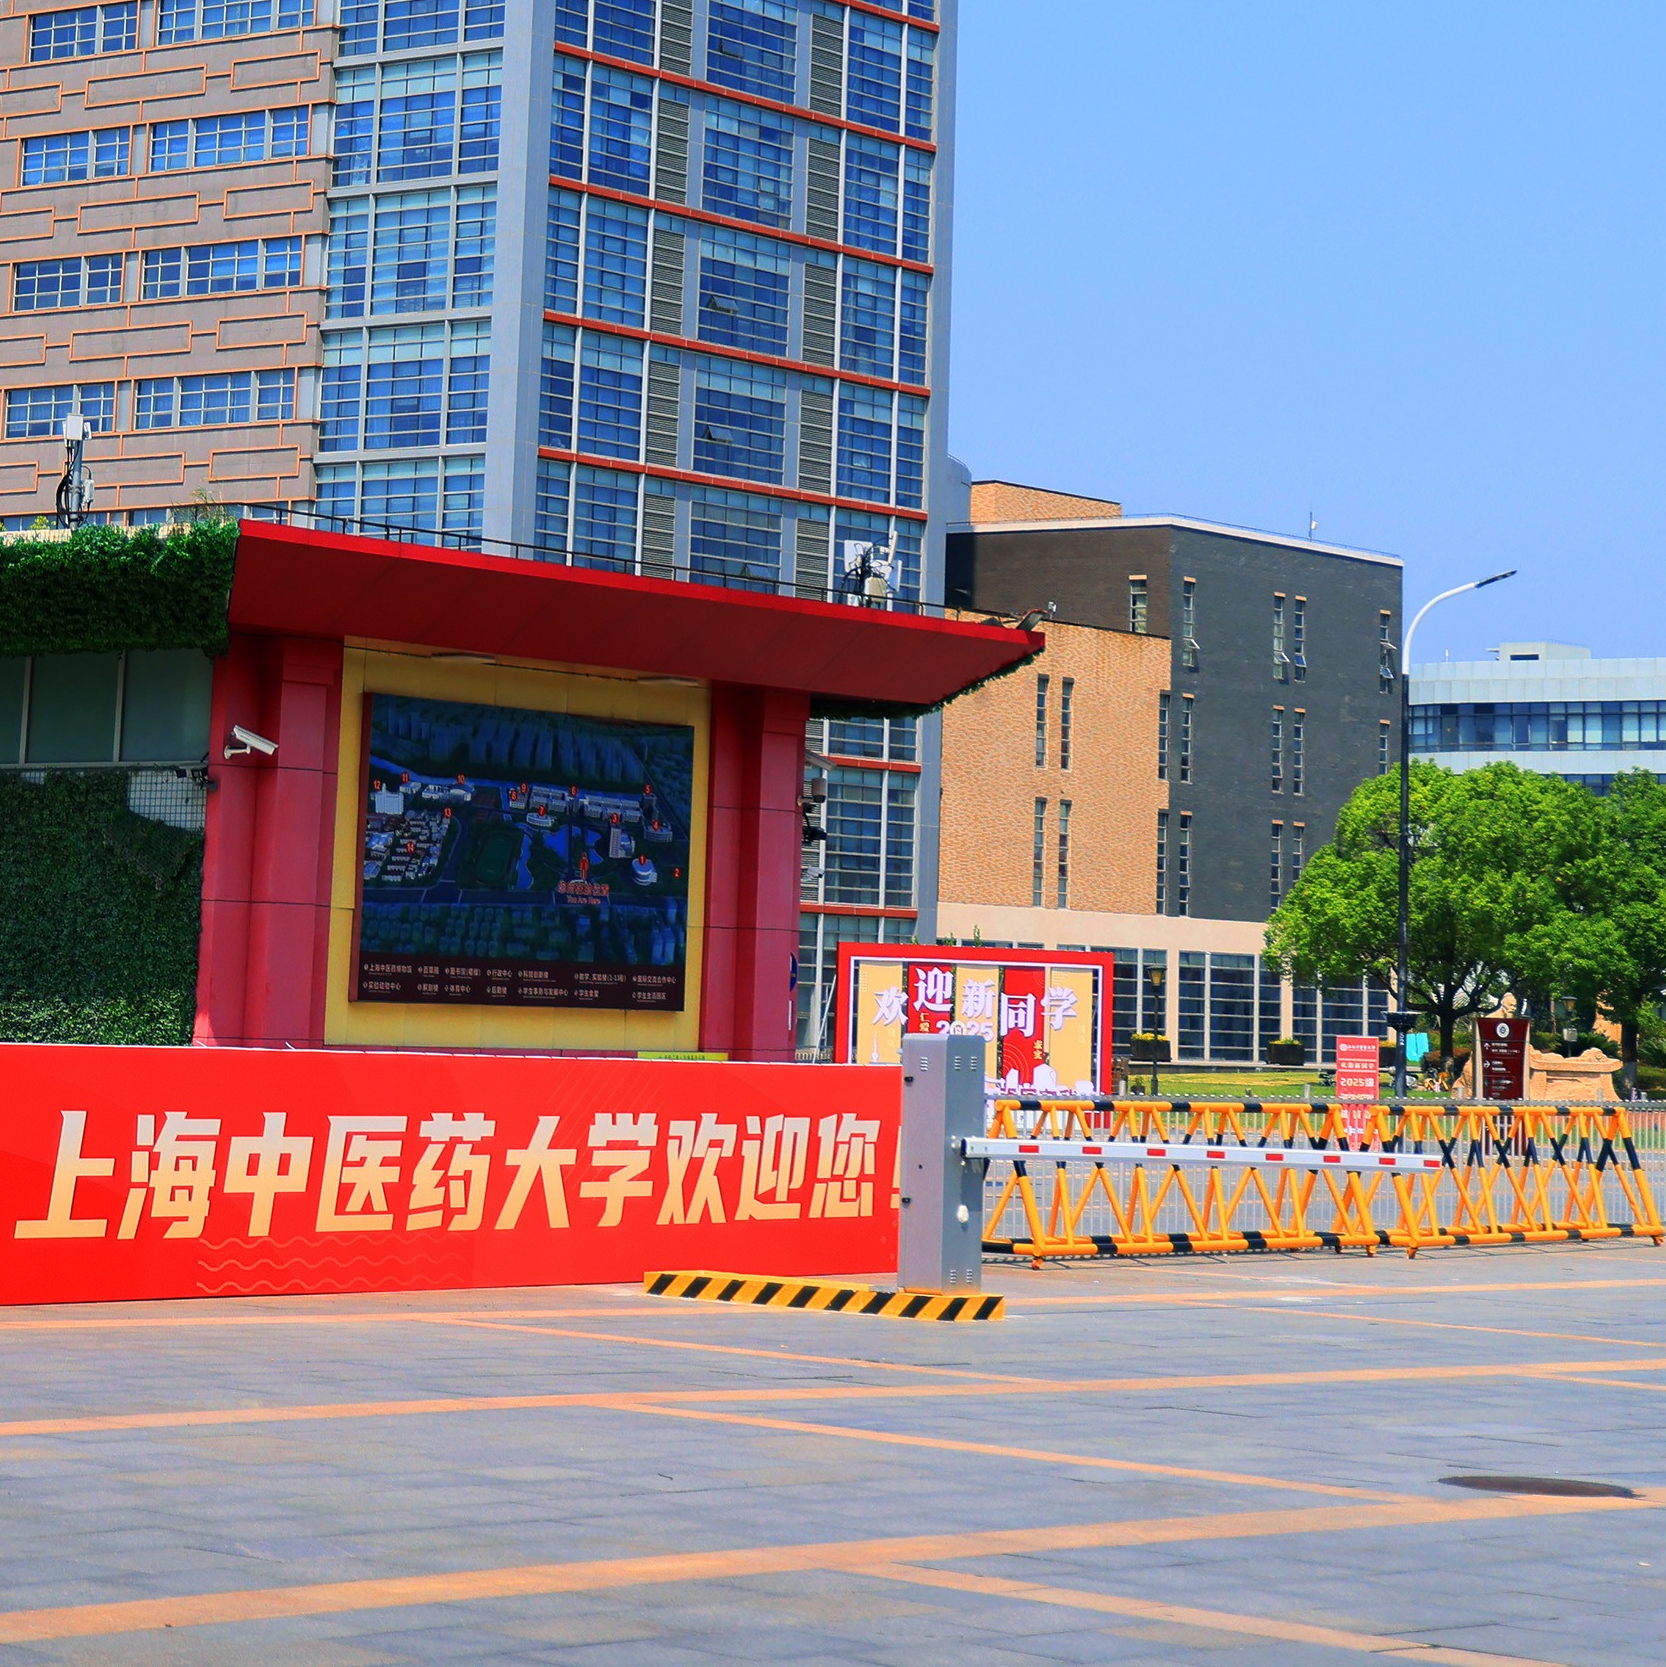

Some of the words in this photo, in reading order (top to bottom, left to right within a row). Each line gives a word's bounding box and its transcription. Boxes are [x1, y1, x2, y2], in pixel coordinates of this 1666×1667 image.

[873, 966, 1078, 1037] 欢迎新同学
[1340, 1078, 1375, 1087] 2025级
